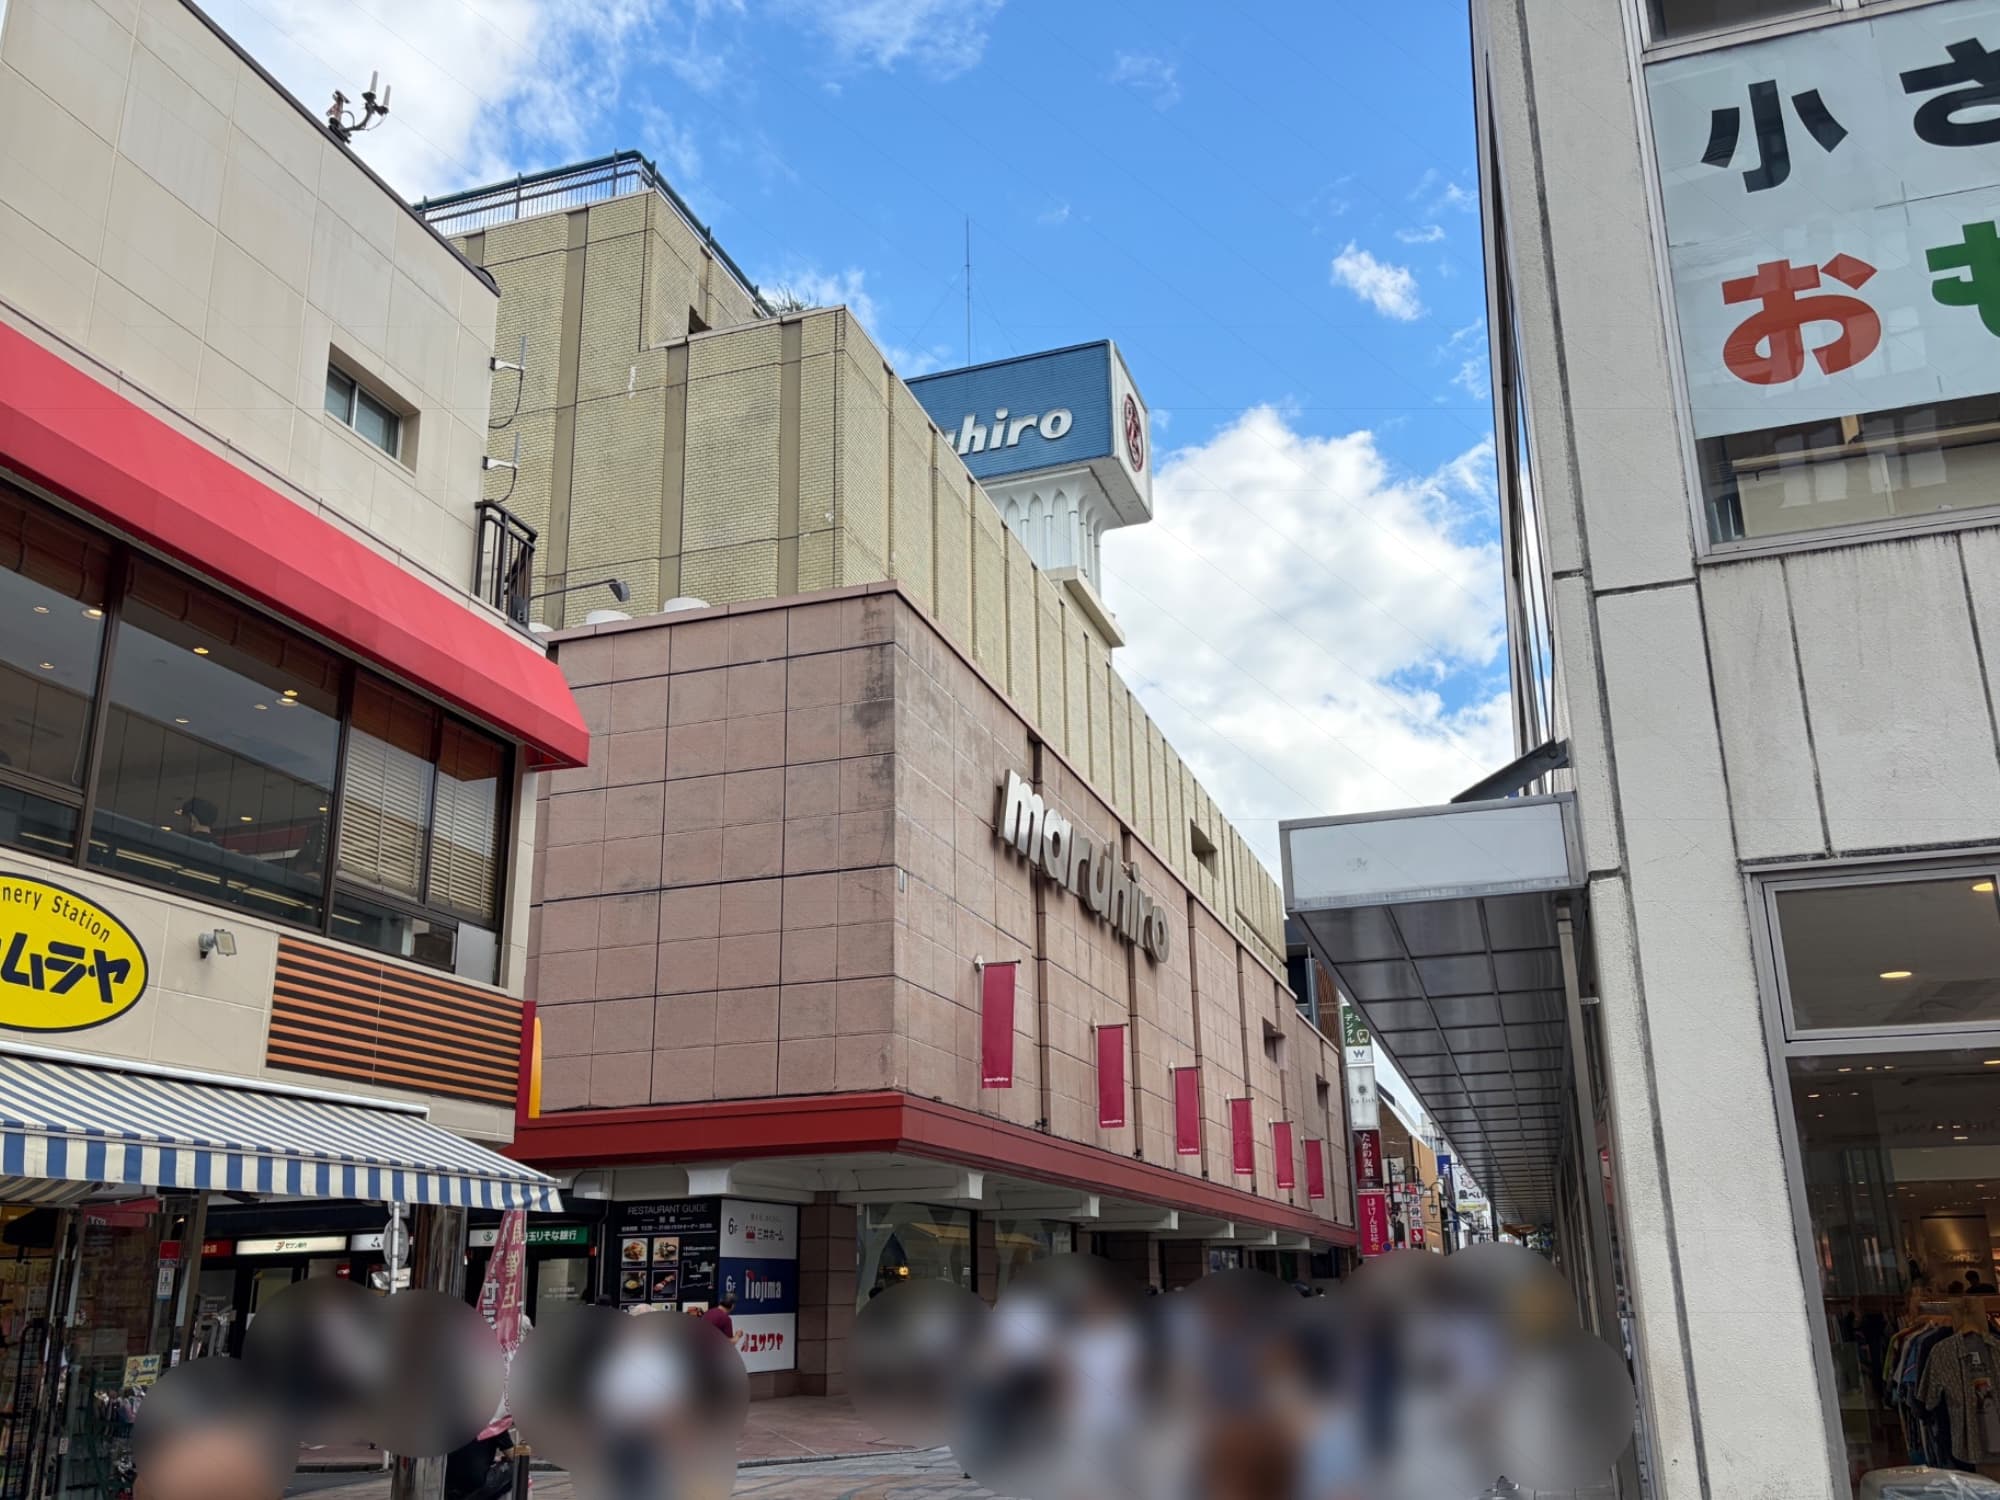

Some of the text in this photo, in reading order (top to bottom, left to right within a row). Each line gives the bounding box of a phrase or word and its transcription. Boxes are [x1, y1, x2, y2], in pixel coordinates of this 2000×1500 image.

[999, 769, 1169, 963] maruhiro
[52, 895, 110, 943] Station
[0, 932, 131, 1004] ムラヤ
[627, 1203, 709, 1216] RESTAURANT GUIDE
[526, 1230, 577, 1241] 玉りそな銀行
